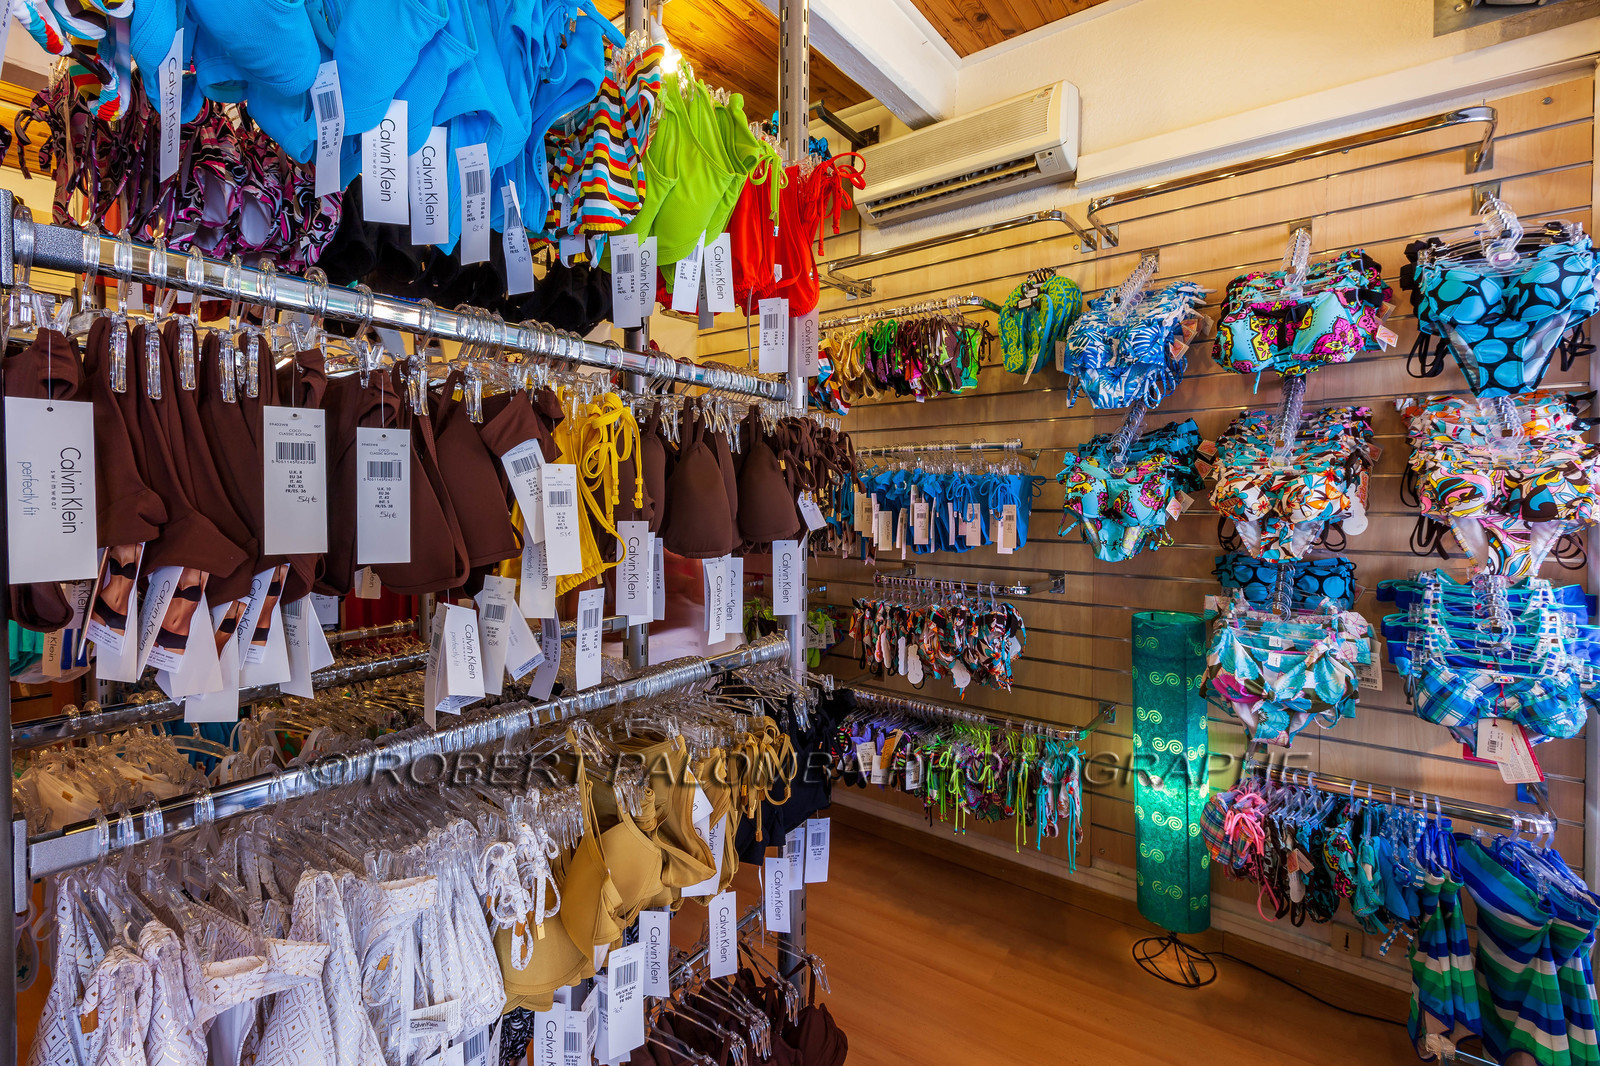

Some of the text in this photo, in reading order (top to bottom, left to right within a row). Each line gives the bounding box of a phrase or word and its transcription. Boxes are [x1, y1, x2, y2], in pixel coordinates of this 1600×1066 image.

[167, 57, 177, 153] Calvin Klein
[380, 118, 396, 202] Calvin Klein
[422, 146, 439, 226] Calvin Klein
[640, 250, 651, 305] Calvin Klein
[714, 245, 726, 300] Calvin Klein
[805, 319, 813, 366] Calvin Klein
[17, 461, 40, 516] perfectly fit
[60, 447, 84, 534] Calvin Klein
[628, 537, 640, 600] Calvin Klein
[782, 552, 792, 603] Calvin Klein
[140, 580, 171, 652] Calvin Klein
[715, 606, 723, 631] Klein
[48, 637, 57, 662] Klein
[464, 623, 478, 680] Calvin Klein
[775, 870, 784, 921] Calvin Klein
[650, 926, 661, 984] Calvin Klein
[719, 906, 730, 963] Calvin Klein
[546, 1020, 557, 1059] Calvin
